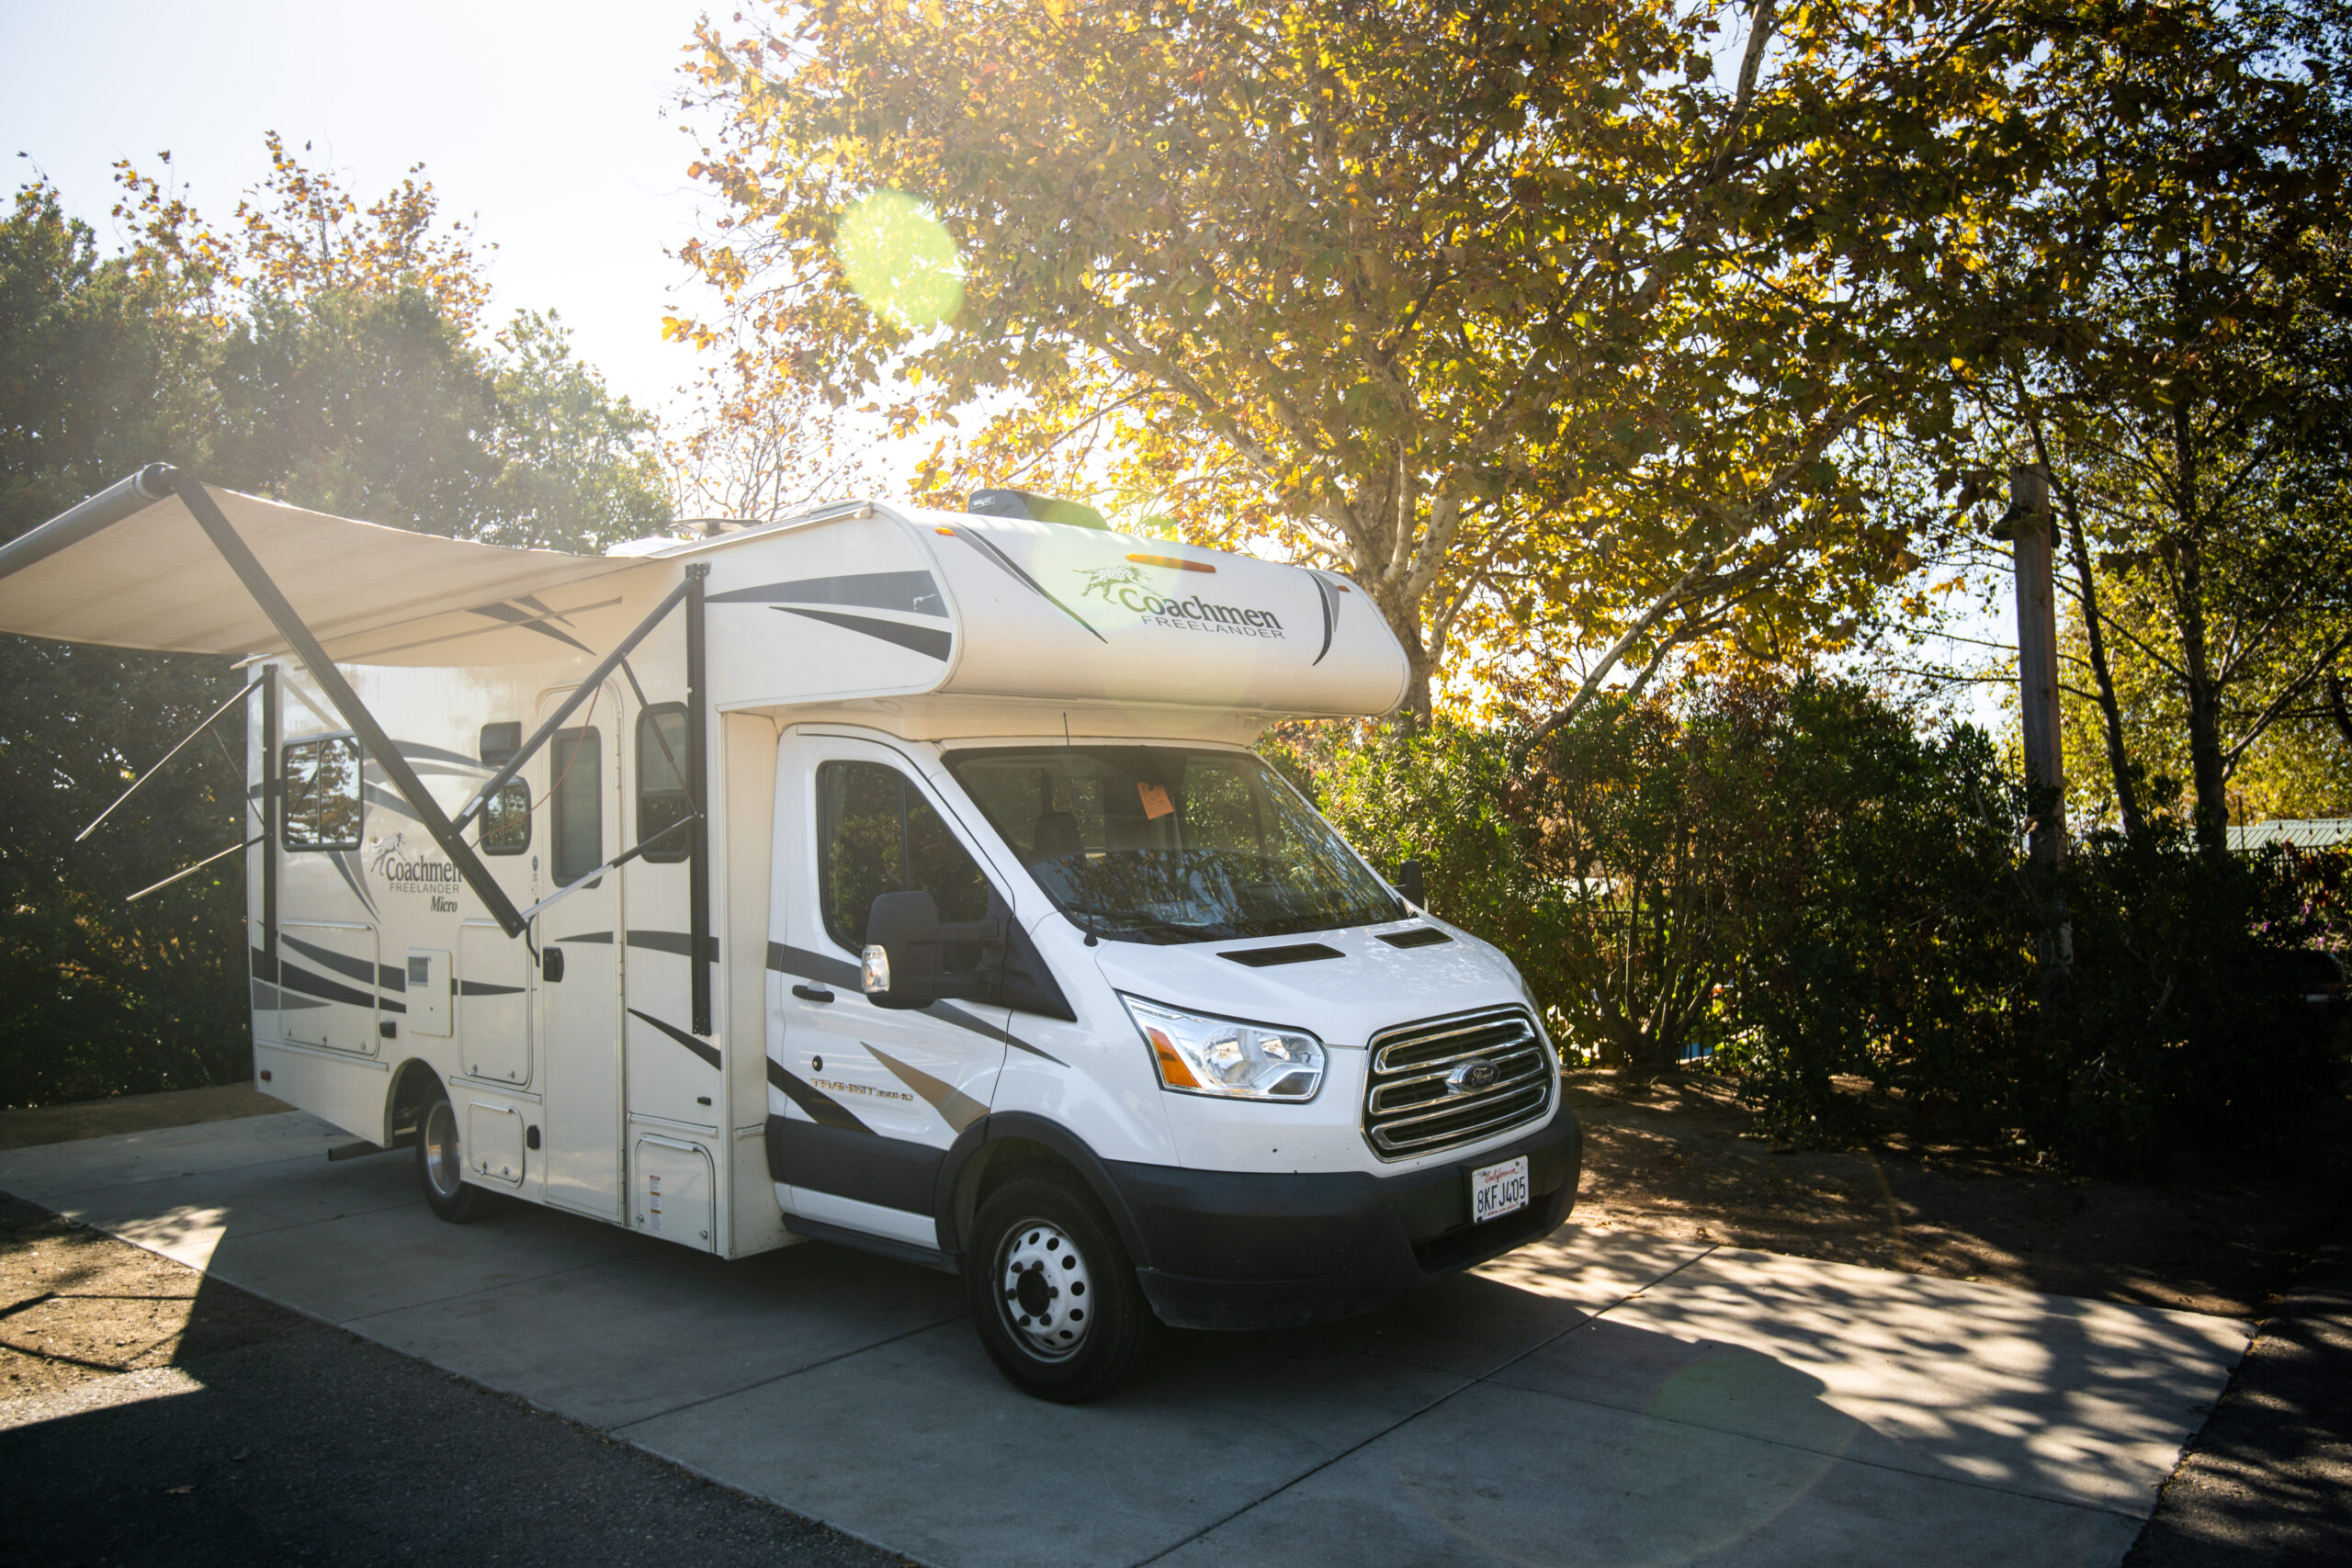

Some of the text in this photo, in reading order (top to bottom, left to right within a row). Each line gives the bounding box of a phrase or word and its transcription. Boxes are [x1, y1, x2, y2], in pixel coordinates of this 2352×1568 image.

[1118, 588, 1284, 629] Coachmen
[1141, 615, 1285, 639] FREELANDER
[390, 883, 459, 895] FREELANDER
[430, 896, 458, 912] Micro
[810, 1077, 876, 1095] TRANSIT
[1472, 1066, 1494, 1087] Ford
[1485, 1168, 1519, 1184] California
[1477, 1176, 1526, 1213] 8KFJ405
